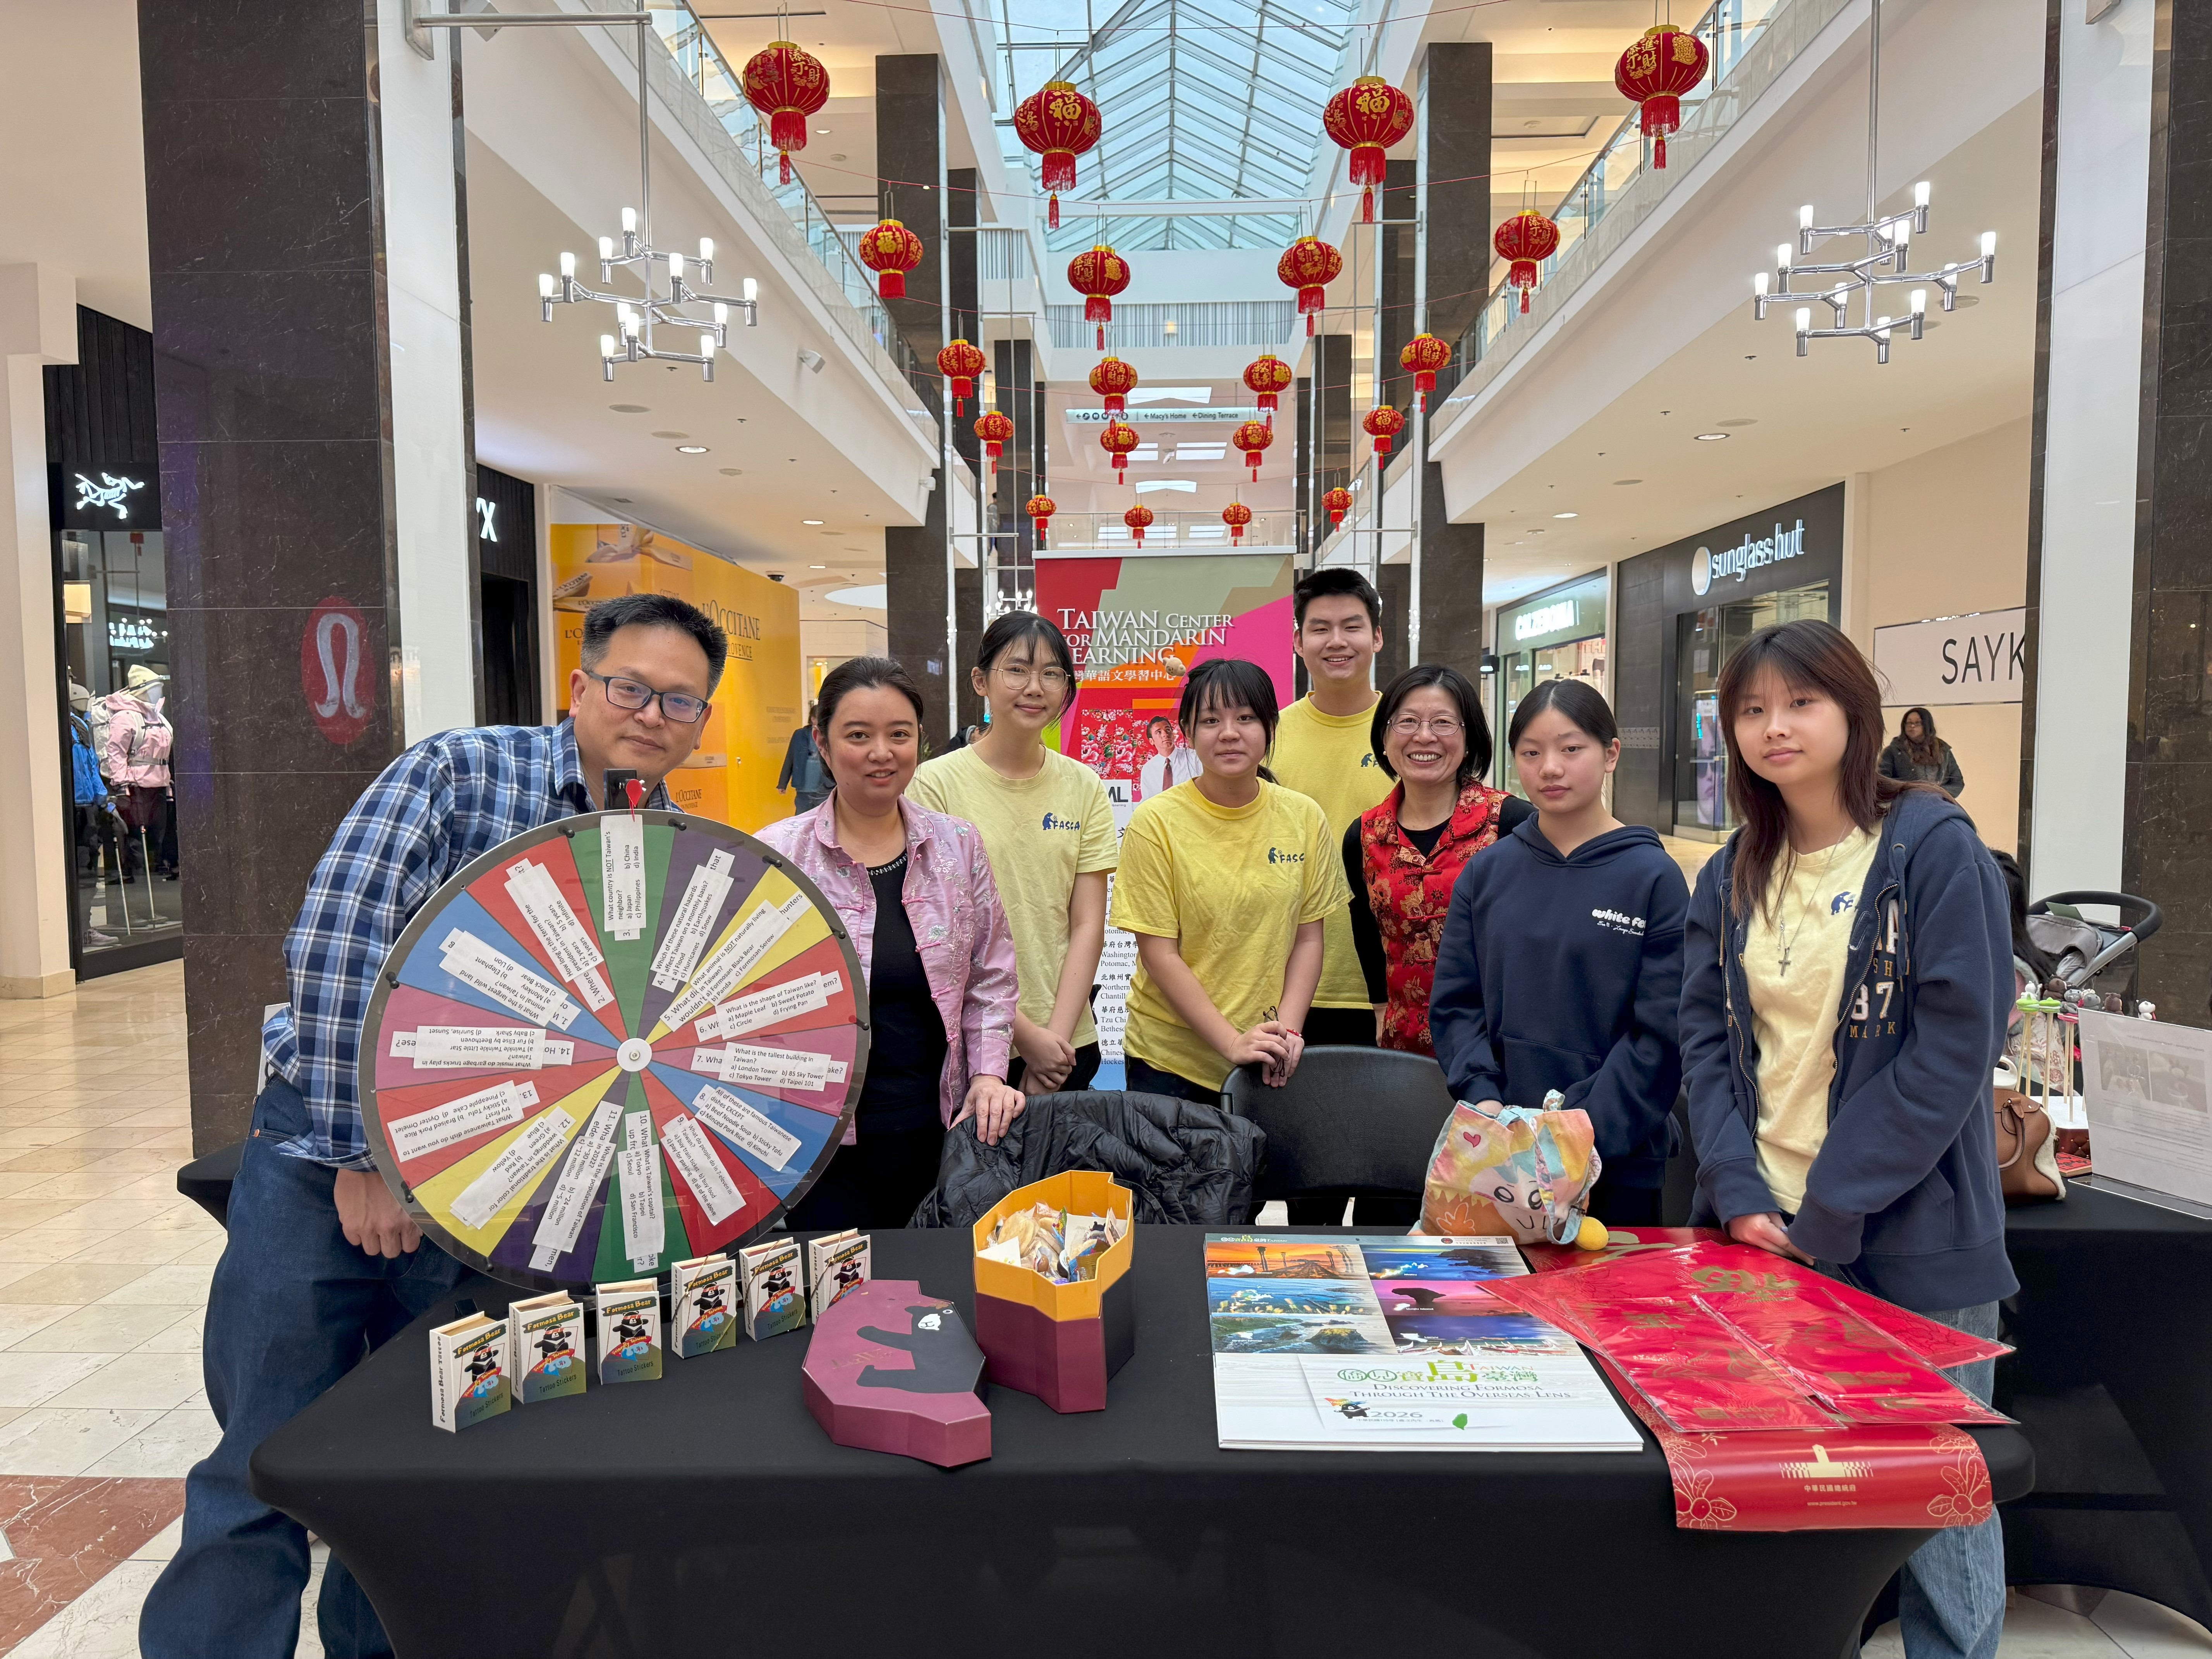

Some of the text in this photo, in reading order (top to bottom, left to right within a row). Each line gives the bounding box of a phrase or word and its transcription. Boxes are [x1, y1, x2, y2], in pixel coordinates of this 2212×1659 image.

[1712, 519, 1805, 582] sunglass hut
[1057, 608, 1235, 629] TAIWAN CENTER
[1063, 627, 1226, 647] OR MANDARIN
[1072, 647, 1174, 664] EARNING
[1942, 632, 2025, 684] SAYK
[616, 890, 624, 919] neighbor?
[1592, 909, 1630, 924] white
[544, 919, 562, 942] Taiwan?
[655, 885, 697, 969] Which of these natural hazards
[692, 972, 707, 986] What
[705, 955, 721, 973] animal
[723, 940, 735, 953] NOT
[734, 921, 754, 942] naturally
[752, 908, 766, 922] living
[563, 946, 582, 971] president
[459, 969, 474, 981] land
[474, 978, 488, 988] wild
[487, 986, 508, 1001] largest
[507, 998, 518, 1006] the
[725, 1005, 742, 1013] What
[759, 994, 776, 1003] shape
[783, 985, 804, 995] Taiwan
[804, 979, 816, 988] like?
[523, 1006, 539, 1020] What
[785, 1053, 807, 1062] building
[519, 1089, 532, 1099] 13.
[710, 1096, 745, 1120] dishes EXCEPT
[495, 1113, 513, 1123] What
[558, 1118, 570, 1128] 12.
[728, 1097, 742, 1109] these
[750, 1111, 768, 1125] famous
[768, 1122, 792, 1141] Taiwanese
[463, 1120, 495, 1134] Taiwanese
[427, 1139, 440, 1147] you
[449, 1132, 462, 1140] dish
[532, 1133, 557, 1156] weddings
[410, 1144, 427, 1153] want
[507, 1161, 529, 1182] Taiwan?
[647, 1197, 655, 1219] capital?
[780, 1252, 793, 1262] Bear
[851, 1243, 864, 1254] Bear
[713, 1269, 728, 1278] Bear
[606, 1303, 634, 1314] Formosa
[527, 1310, 574, 1330] Formosa Bear
[457, 1328, 501, 1355] Formosa Bear
[618, 1362, 653, 1377] Tattoo Stickers
[539, 1374, 577, 1394] Tattoo Stickers
[470, 1392, 503, 1418] Tattoo Stickers
